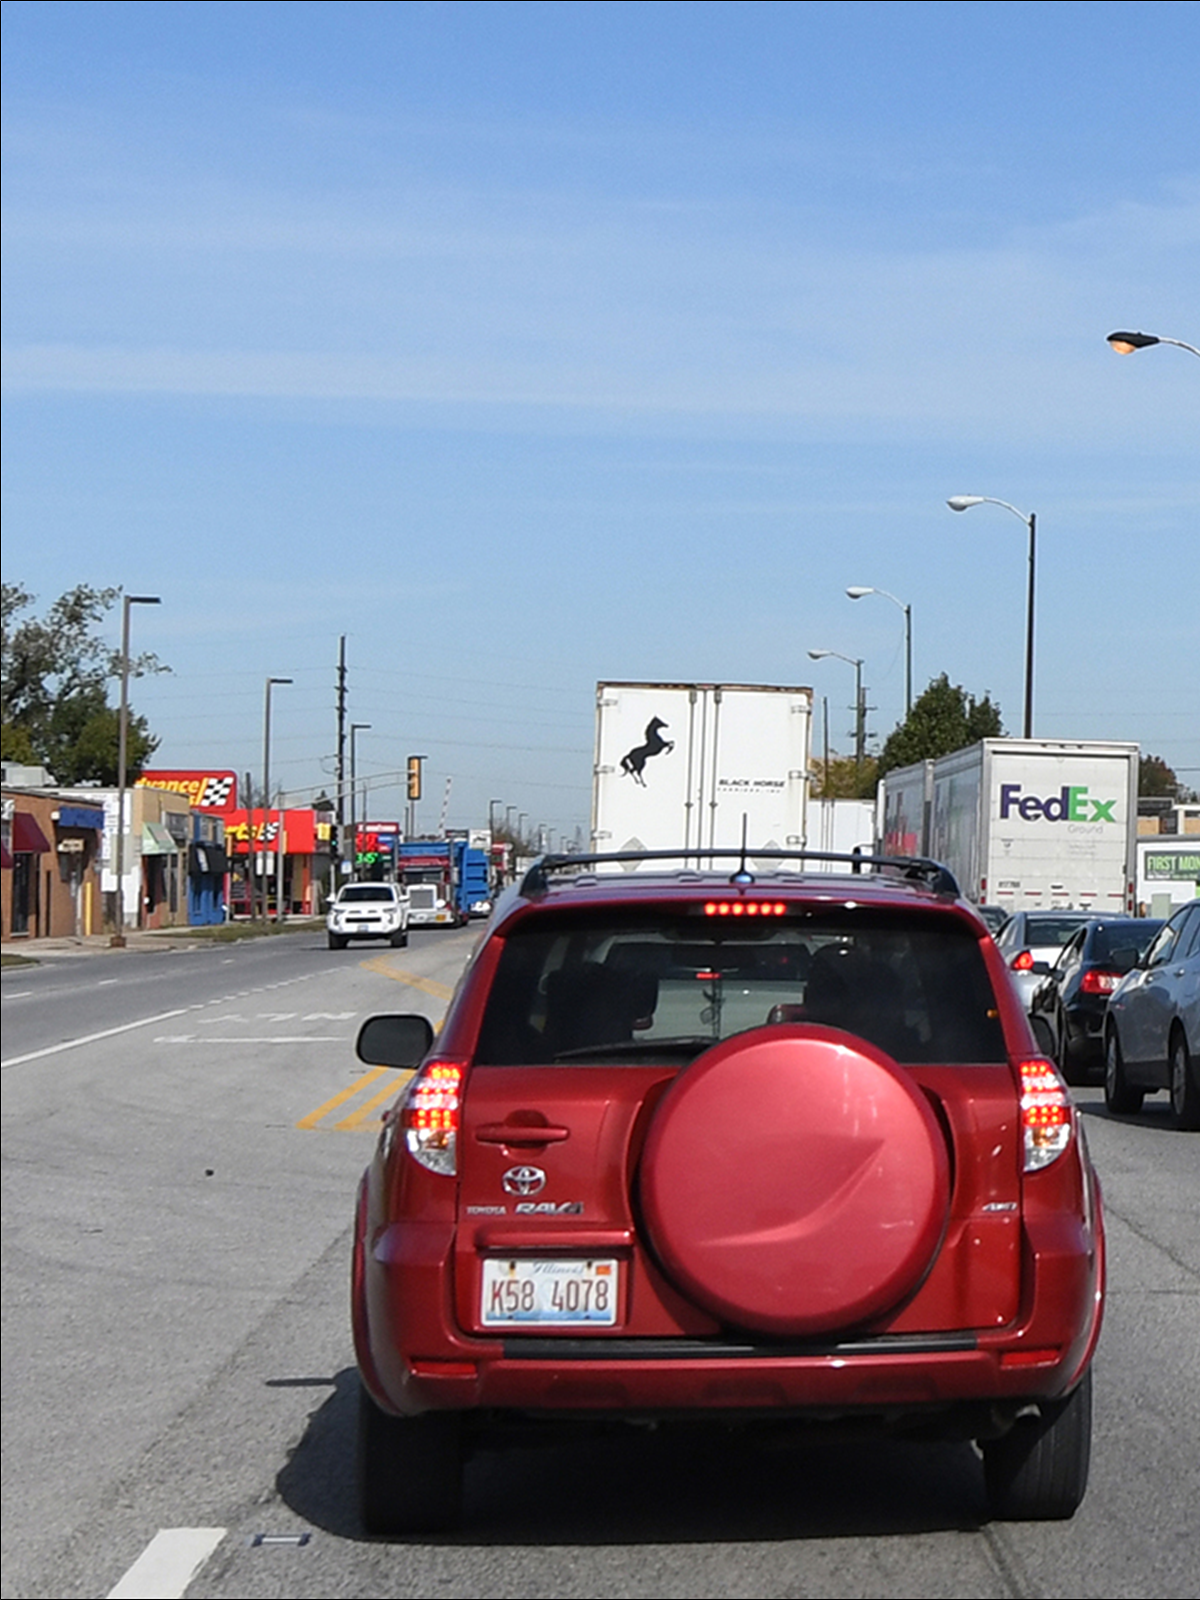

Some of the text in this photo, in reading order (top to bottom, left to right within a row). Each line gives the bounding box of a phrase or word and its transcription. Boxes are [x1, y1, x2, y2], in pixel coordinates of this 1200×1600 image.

[753, 780, 785, 788] HORSE
[1000, 784, 1117, 822] FedEx
[1147, 857, 1176, 870] FIRST
[467, 1202, 584, 1215] TOYOTA RAV4
[533, 1260, 585, 1274] Illinois
[491, 1280, 608, 1312] K58 4078
